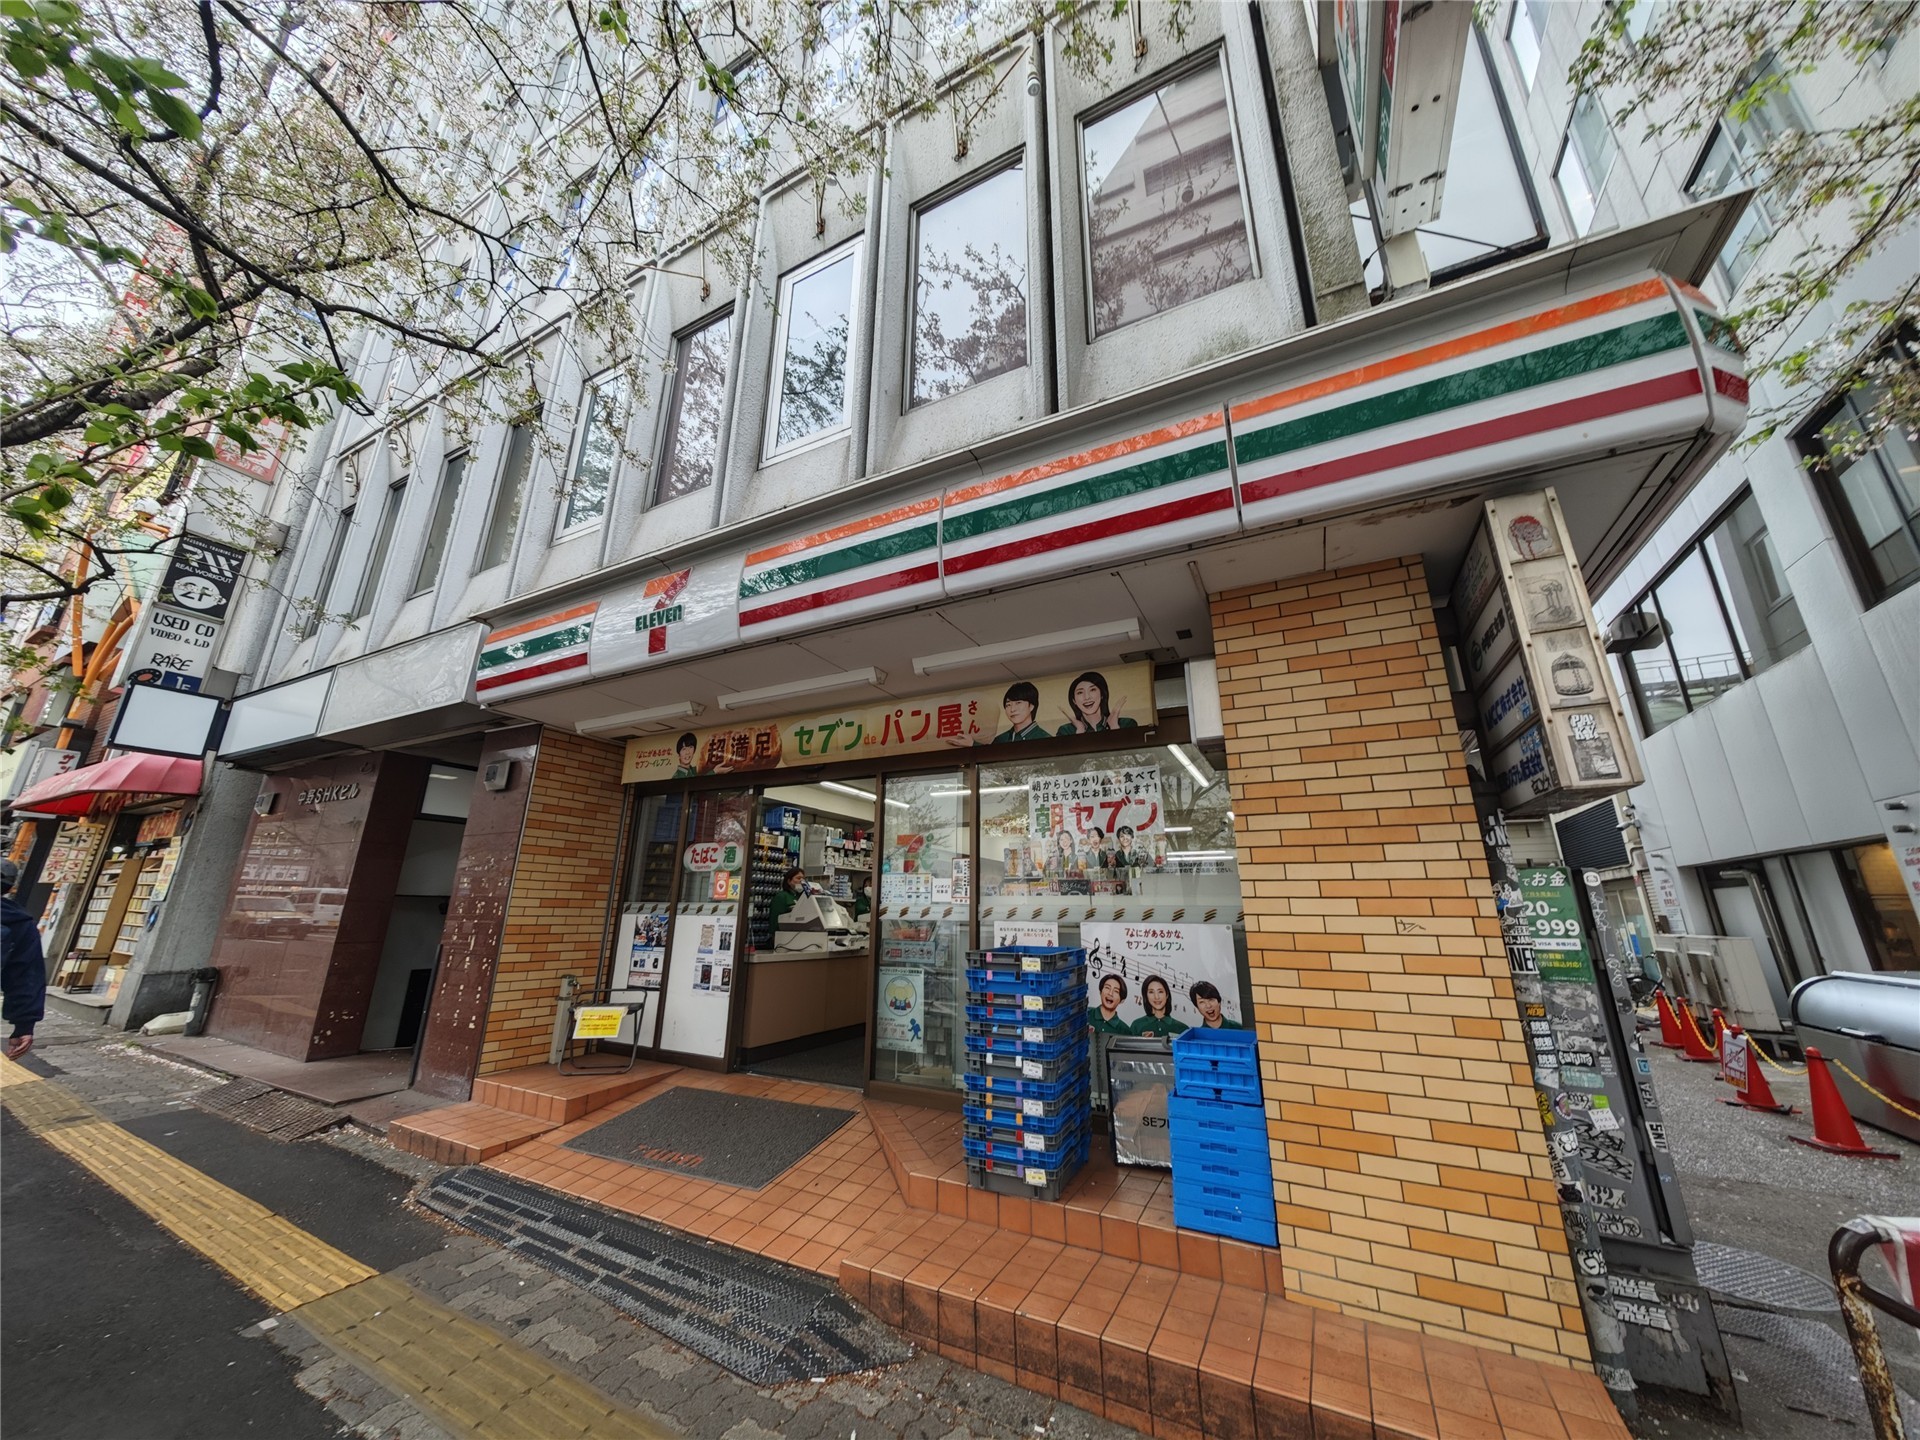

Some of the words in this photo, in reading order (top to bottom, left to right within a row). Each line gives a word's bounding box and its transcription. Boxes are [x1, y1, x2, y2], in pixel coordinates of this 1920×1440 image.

[175, 562, 195, 574] REAL
[194, 567, 233, 584] WORKOUT
[179, 582, 214, 602] 2F
[153, 612, 190, 631] USED
[195, 623, 216, 638] CD
[150, 627, 182, 642] VIDEO
[184, 637, 191, 645] &
[194, 638, 210, 649] LD
[150, 652, 194, 671] RARE
[794, 717, 863, 757] セブン
[863, 733, 877, 746] de
[880, 703, 964, 747] パン屋
[967, 700, 981, 735] さん
[706, 732, 772, 766] 超満足
[1032, 775, 1100, 792] 朝からしっかり
[1123, 769, 1157, 784] 食べて
[1034, 795, 1158, 839] 朝セブン
[690, 847, 719, 864] たばこ
[723, 846, 737, 863] 酒
